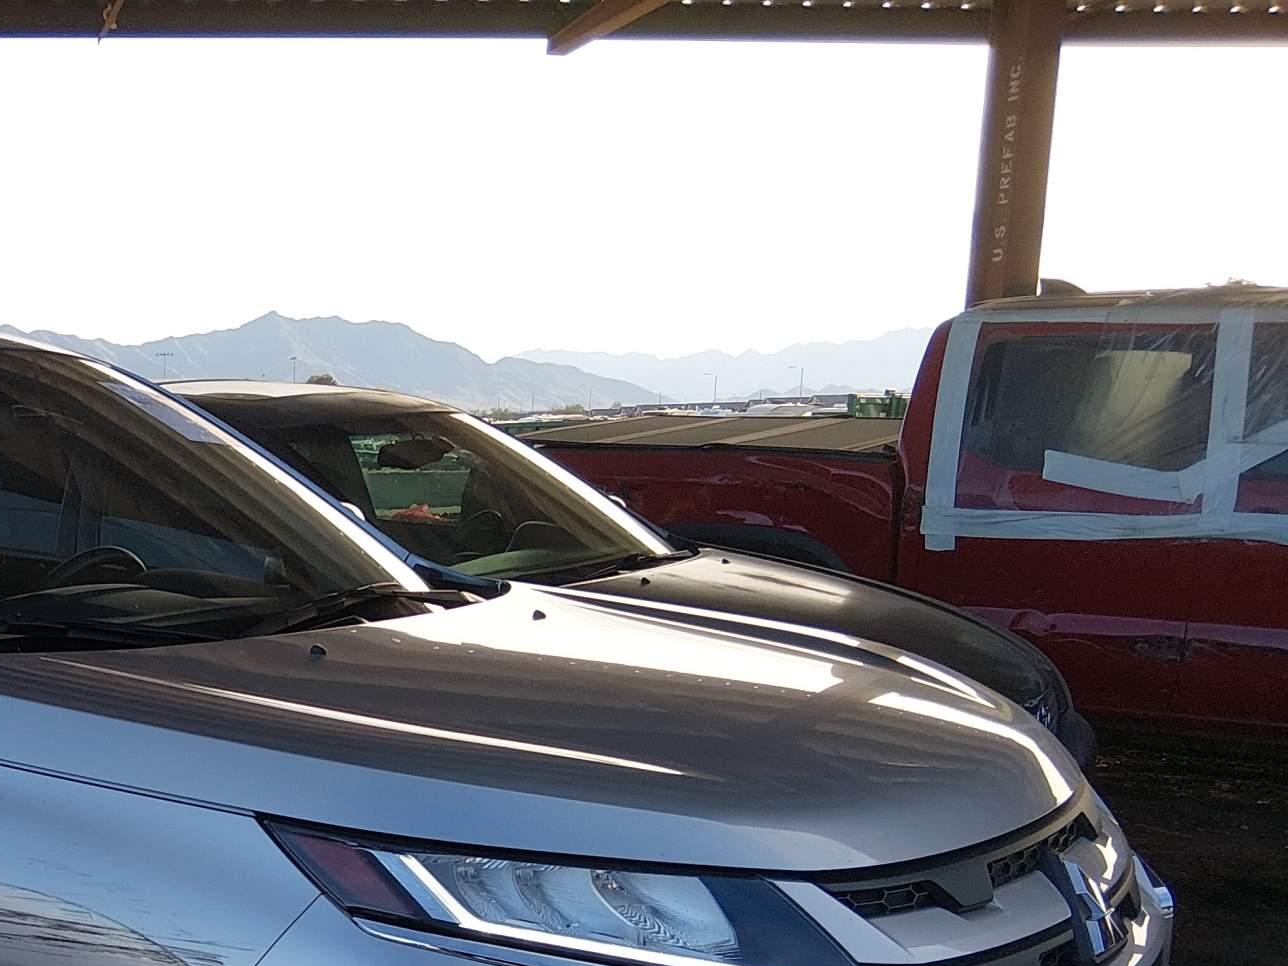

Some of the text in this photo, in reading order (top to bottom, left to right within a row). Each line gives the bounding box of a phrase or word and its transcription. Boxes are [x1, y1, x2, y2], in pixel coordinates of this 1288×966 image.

[991, 56, 1024, 263] U.S. PREFAB INC.
